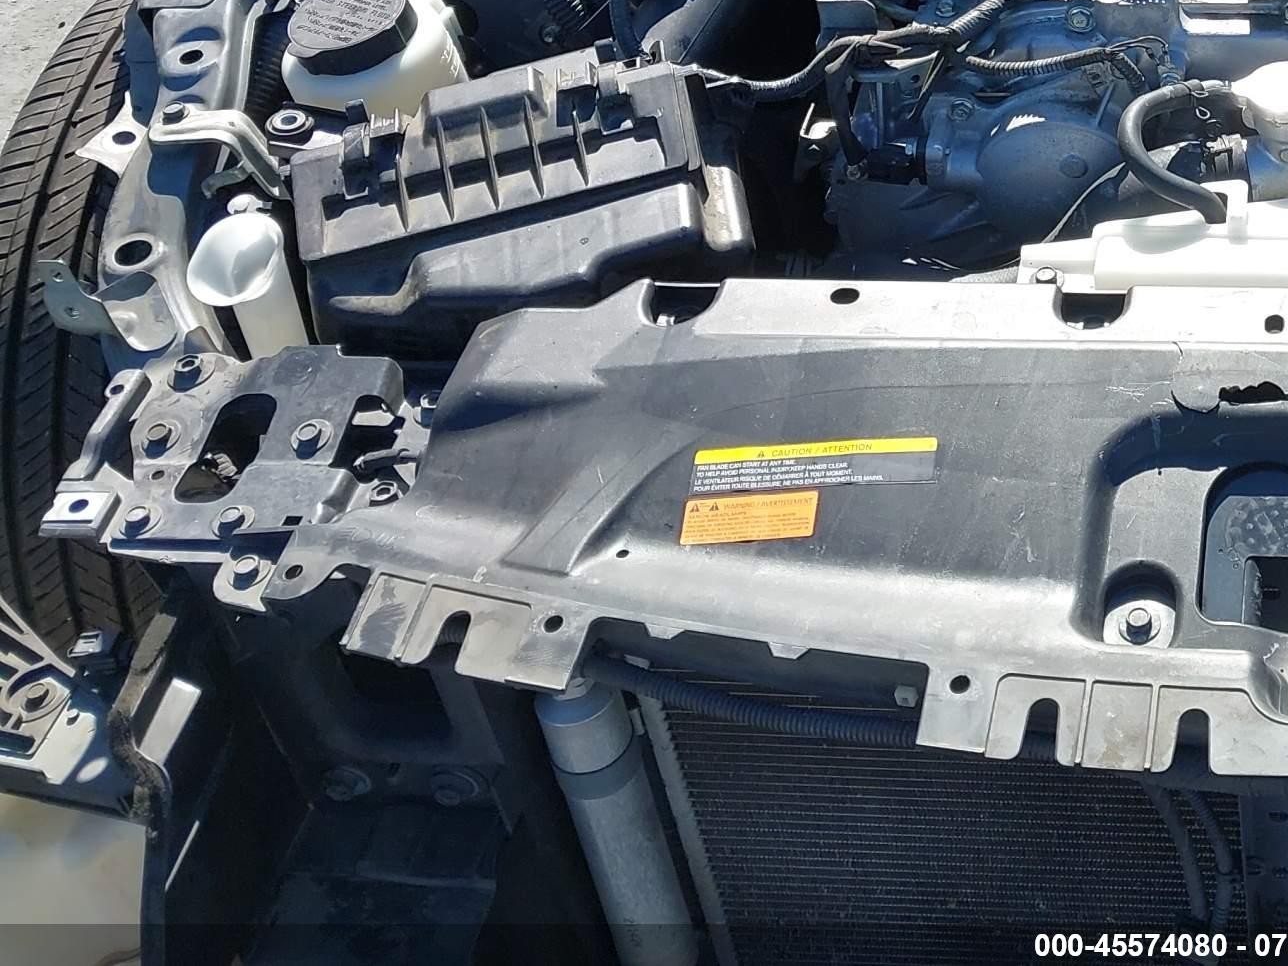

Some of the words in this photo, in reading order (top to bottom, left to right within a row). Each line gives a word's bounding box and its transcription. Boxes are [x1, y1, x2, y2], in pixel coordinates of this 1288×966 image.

[771, 447, 811, 457] CAUTION
[822, 443, 872, 454] ATTENTION
[703, 476, 739, 485] VENTILATEUR
